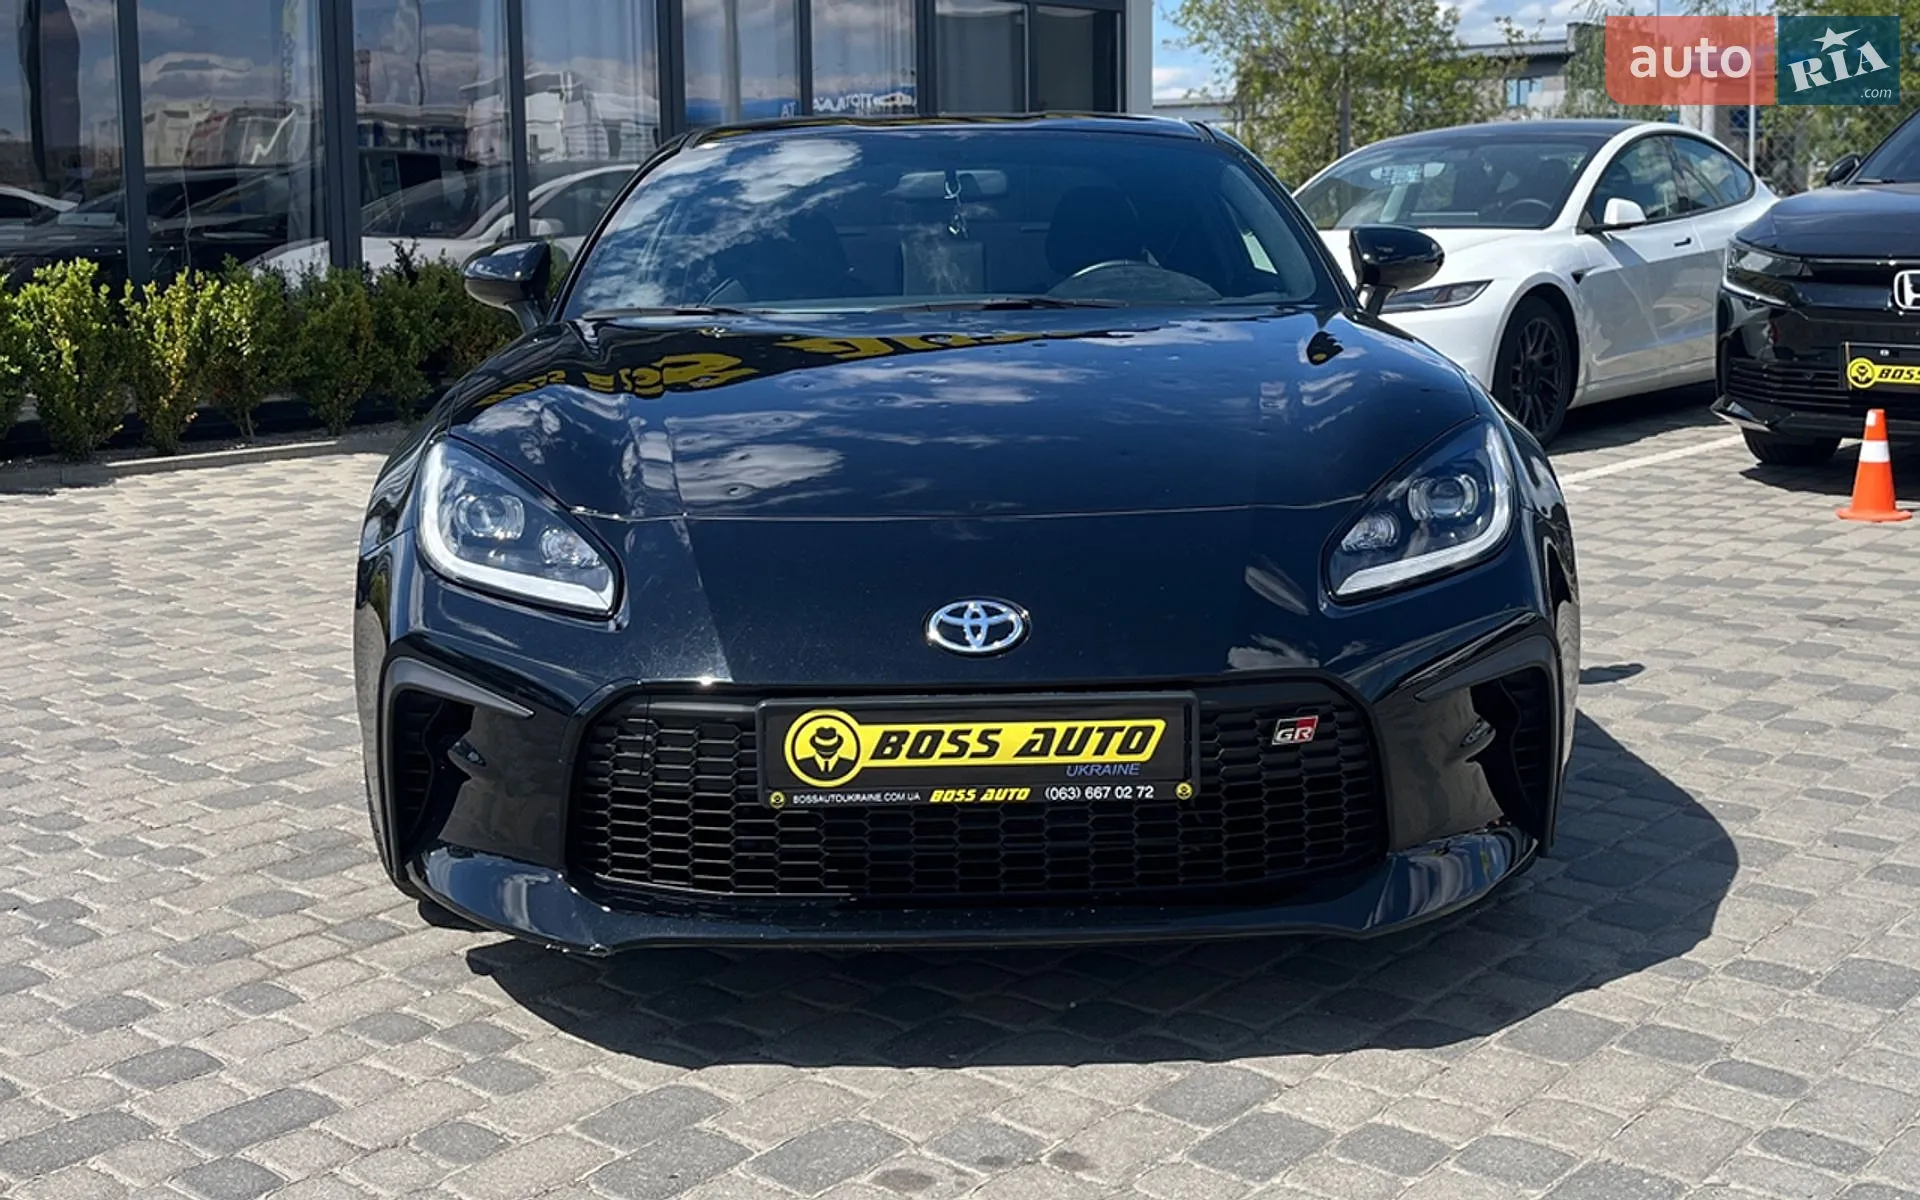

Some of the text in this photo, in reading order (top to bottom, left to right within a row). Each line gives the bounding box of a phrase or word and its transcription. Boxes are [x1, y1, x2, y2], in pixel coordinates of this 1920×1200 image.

[870, 725, 1156, 760] BOSS AUTO
[1275, 727, 1315, 742] GR
[1066, 763, 1141, 777] UKRAINE
[929, 787, 1031, 803] BOSS AUTO
[1045, 785, 1154, 801] (063) 667 02 72
